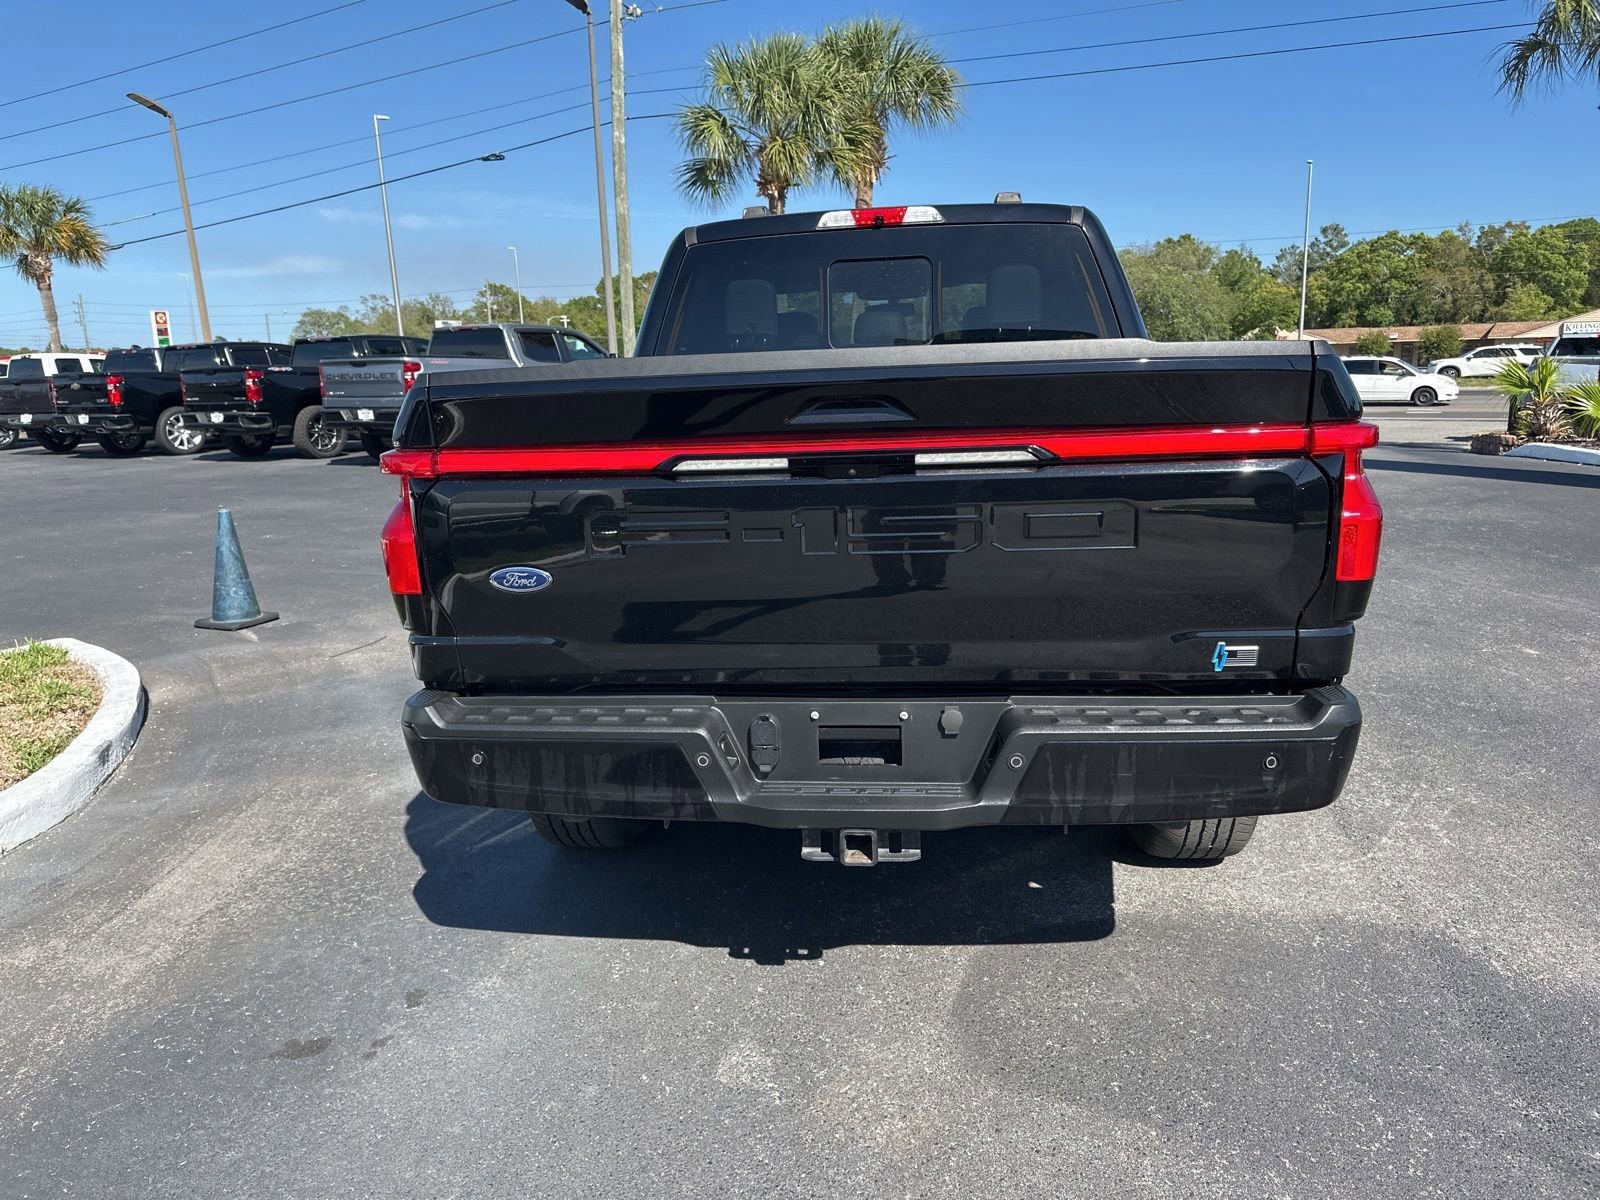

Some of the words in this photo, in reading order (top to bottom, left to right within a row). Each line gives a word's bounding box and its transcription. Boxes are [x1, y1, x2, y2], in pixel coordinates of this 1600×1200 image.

[1565, 323, 1600, 331] KILLING
[326, 372, 397, 380] CHEVROLET
[585, 499, 1137, 559] F-150
[503, 572, 537, 587] Ford
